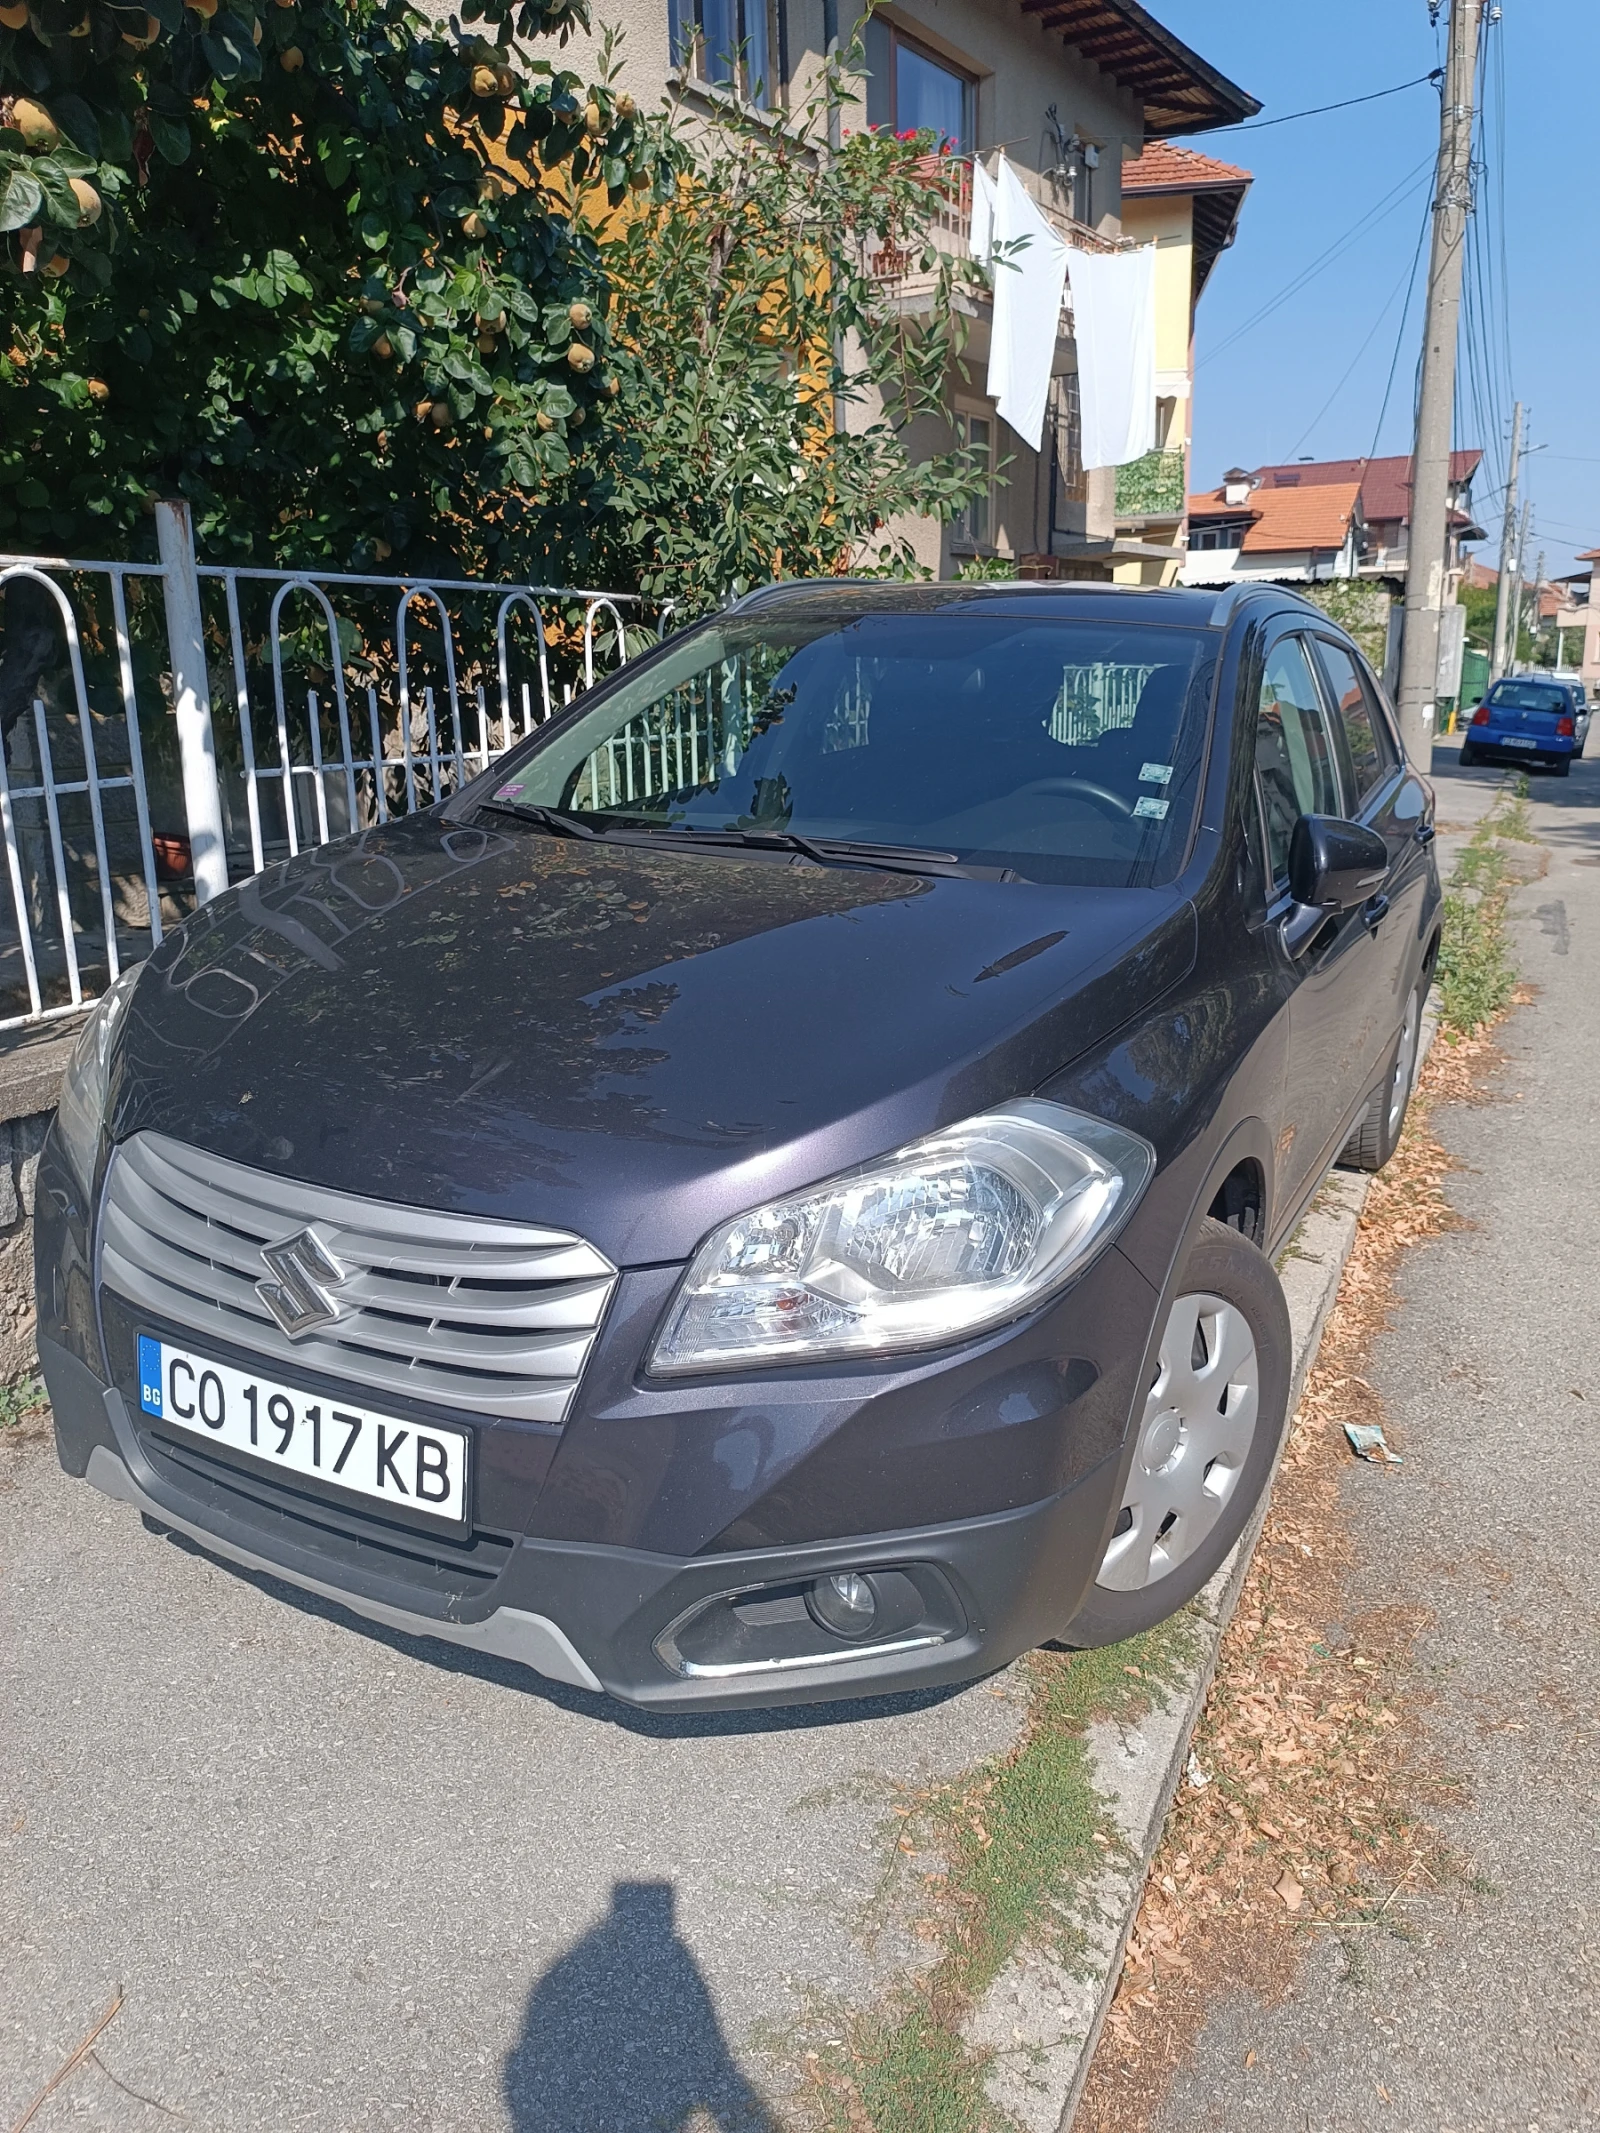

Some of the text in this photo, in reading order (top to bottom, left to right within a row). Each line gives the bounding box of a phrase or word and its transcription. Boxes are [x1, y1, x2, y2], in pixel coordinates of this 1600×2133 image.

[143, 1384, 161, 1405] BG
[243, 1384, 362, 1474] 1917
[377, 1424, 451, 1503] KB
